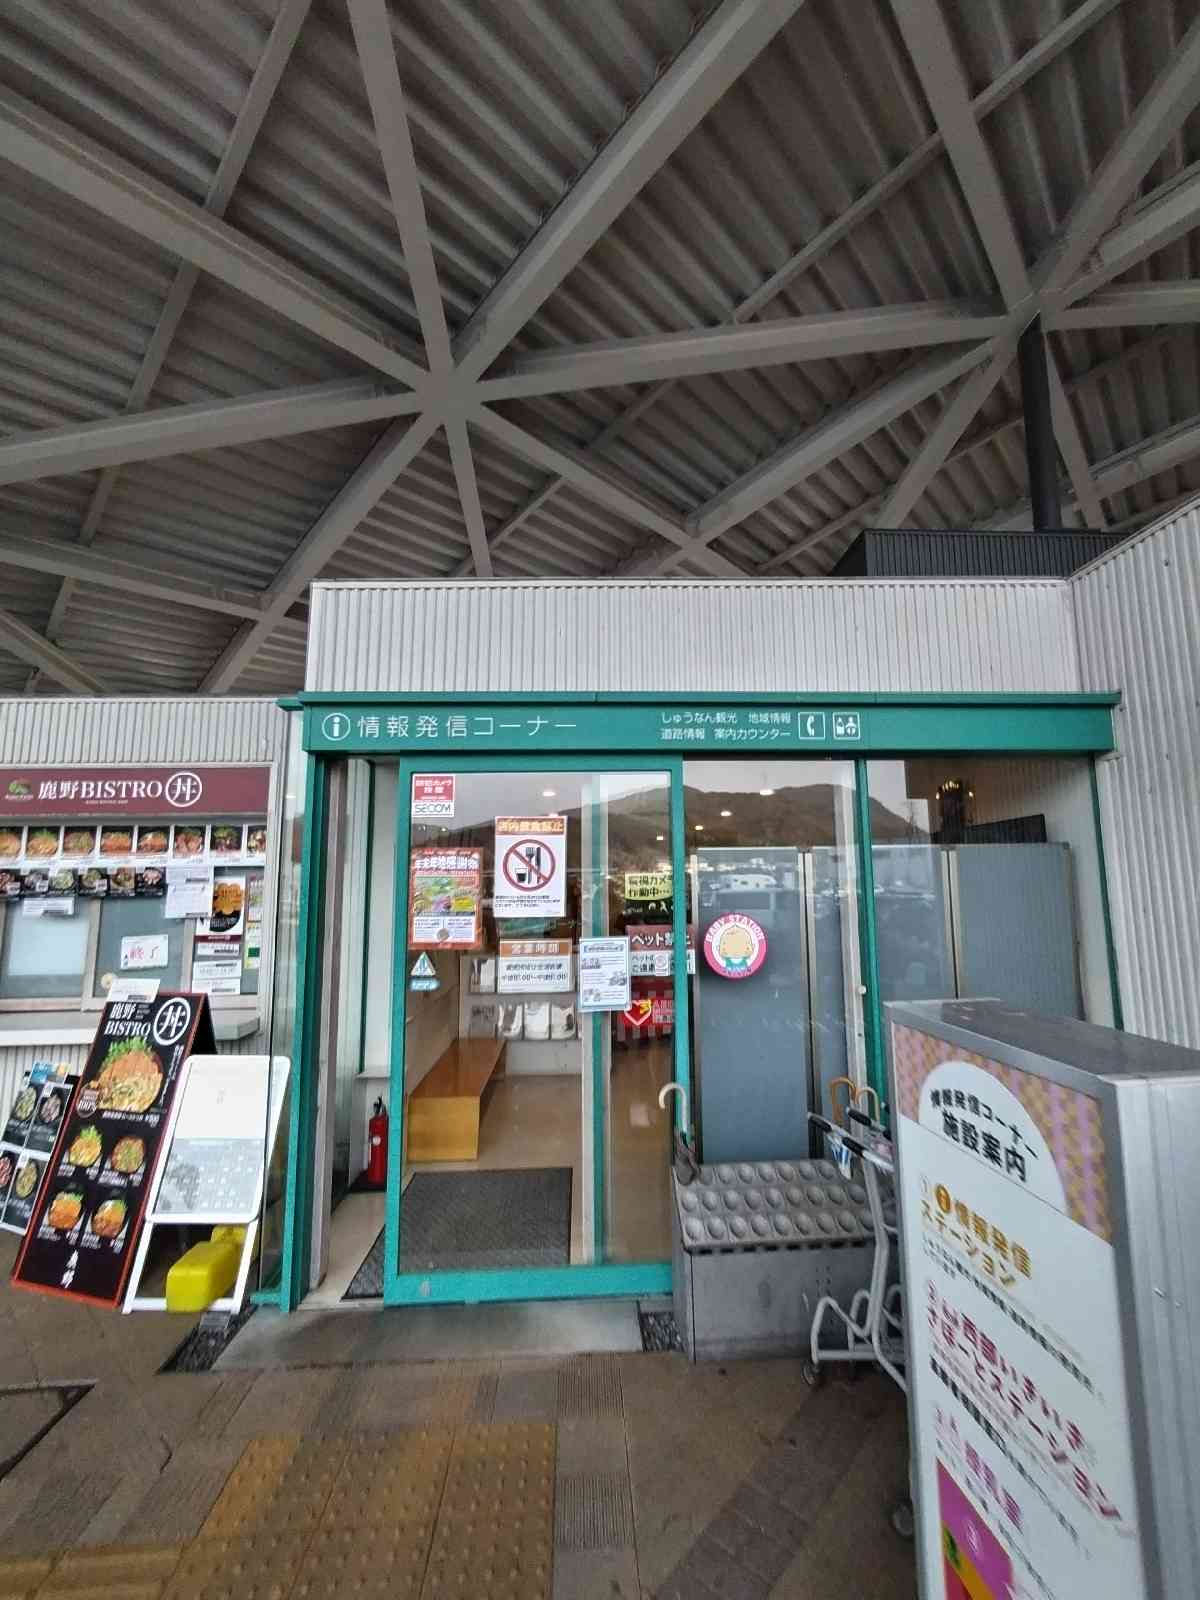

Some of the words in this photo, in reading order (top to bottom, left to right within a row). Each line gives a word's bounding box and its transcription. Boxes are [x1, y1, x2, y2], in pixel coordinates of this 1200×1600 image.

[357, 715, 577, 738] 情報発信コーナー
[661, 712, 738, 724] しゅうなん観光
[749, 712, 792, 723] 地域情報
[661, 728, 705, 740] 道路情報
[714, 728, 792, 740] 案内カウンター
[415, 804, 451, 813] SECOM
[705, 917, 725, 942] BABY
[727, 914, 765, 941] STATION
[511, 943, 559, 954] 営業時間
[104, 1021, 152, 1041] BISTRO
[930, 1088, 1039, 1160] 情報発信コーナー
[941, 1110, 1027, 1183] 施設案内
[921, 1199, 1016, 1286] ステーション
